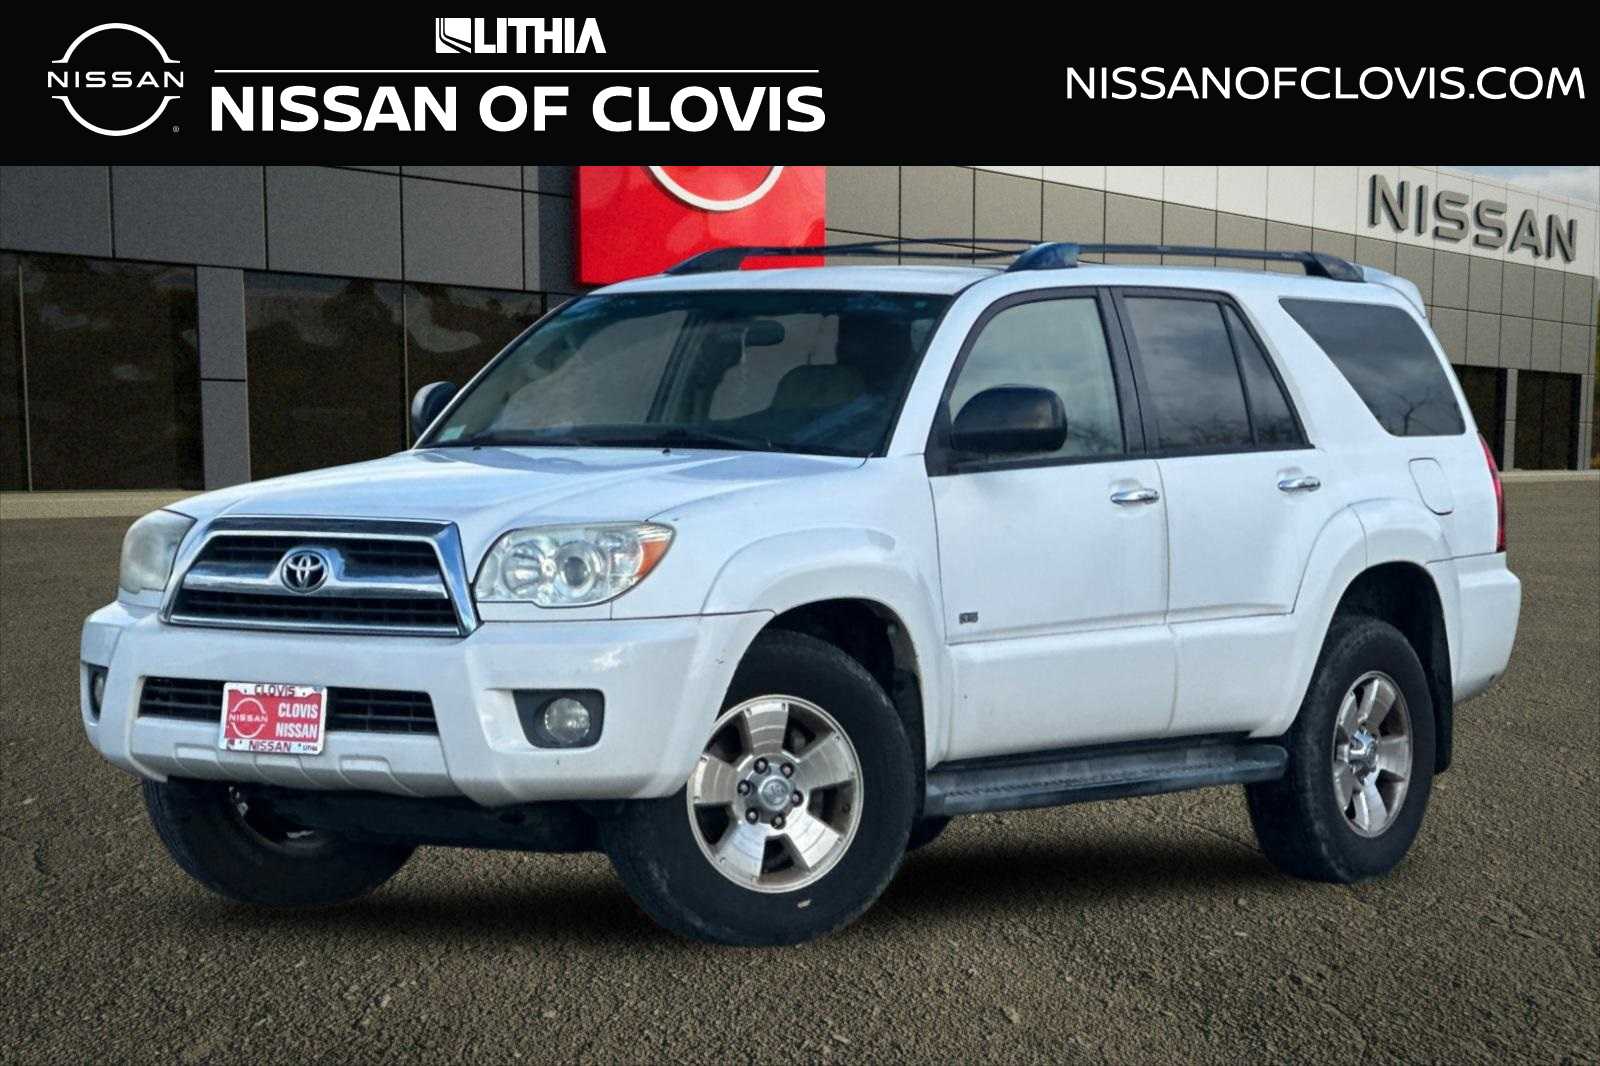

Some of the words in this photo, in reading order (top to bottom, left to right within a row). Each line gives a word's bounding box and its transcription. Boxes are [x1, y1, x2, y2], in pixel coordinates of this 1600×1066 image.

[1368, 174, 1578, 263] NISSAN
[255, 684, 296, 697] CLOVIS
[228, 713, 268, 723] NISSAN
[277, 702, 319, 719] CLOVIS
[275, 722, 318, 739] NISSAN
[249, 740, 292, 752] NISSAN
